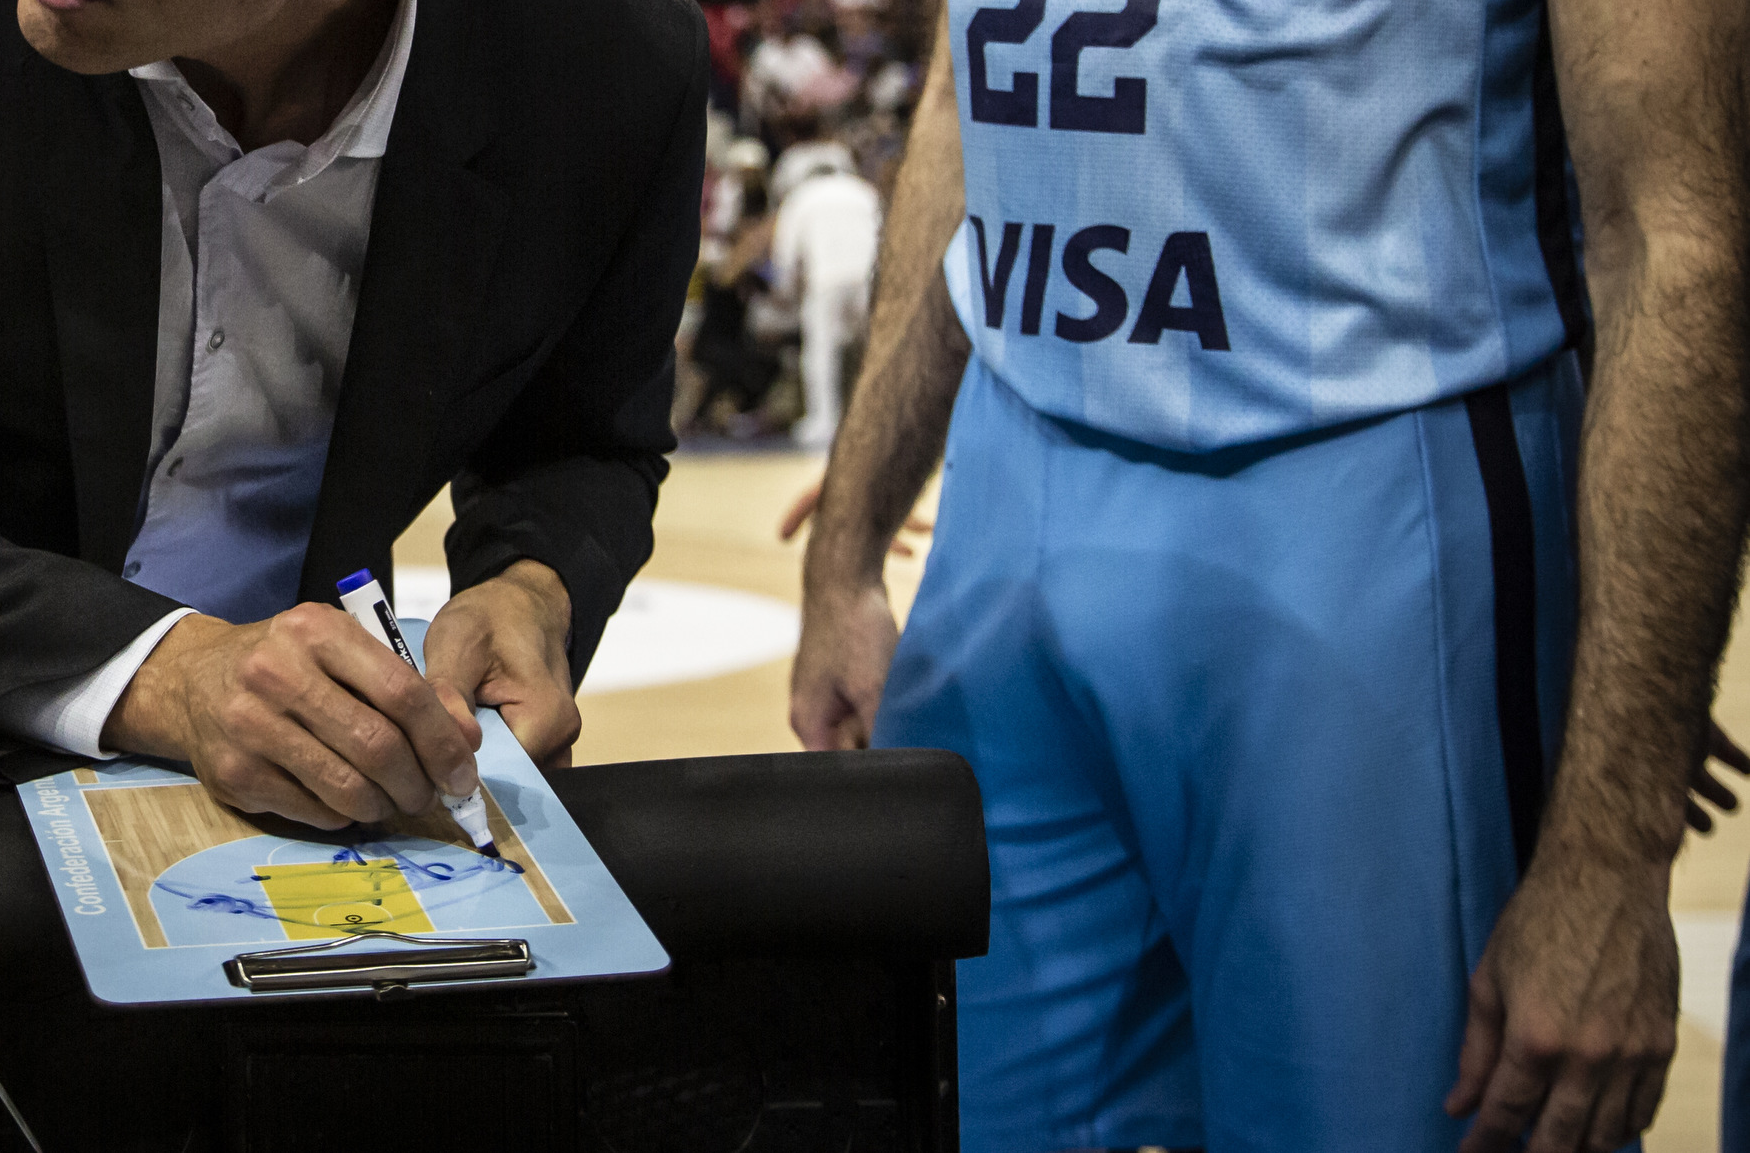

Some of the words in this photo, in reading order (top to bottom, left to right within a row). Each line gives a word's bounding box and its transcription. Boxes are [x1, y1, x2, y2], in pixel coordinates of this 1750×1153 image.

[968, 214, 1232, 353] VISA
[394, 637, 415, 668] arker
[47, 819, 107, 915] Confederación
